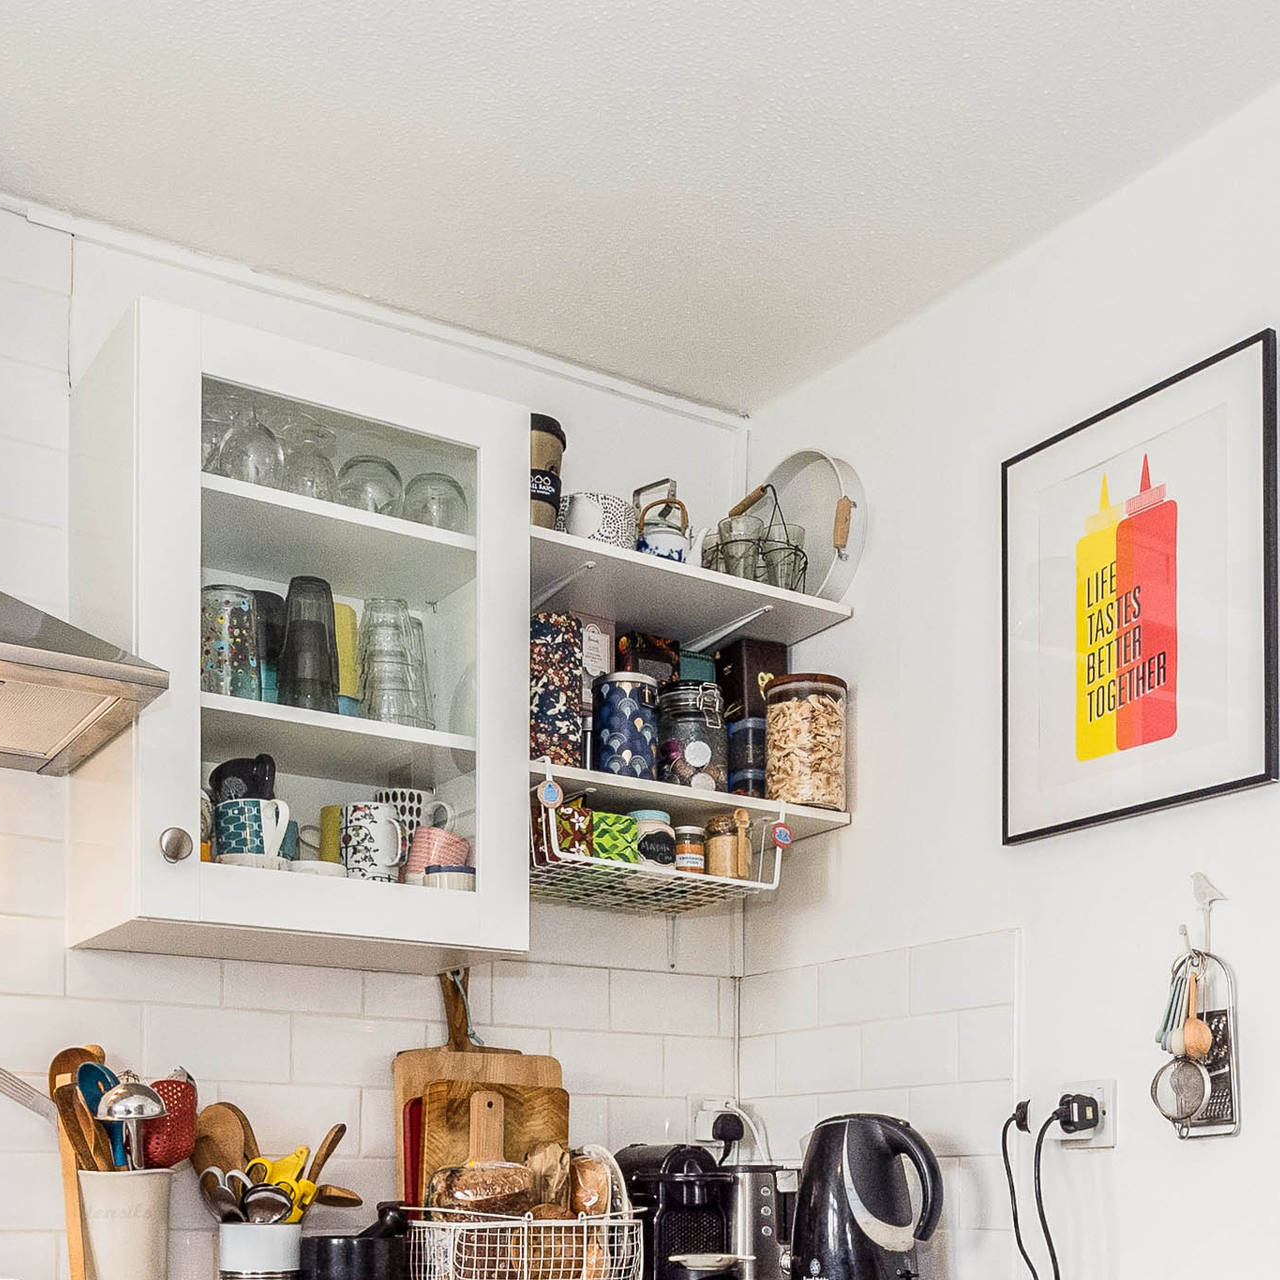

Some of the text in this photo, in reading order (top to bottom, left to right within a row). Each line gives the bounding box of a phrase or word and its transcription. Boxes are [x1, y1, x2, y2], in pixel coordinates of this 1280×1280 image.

[1084, 559, 1119, 610] LIFE
[1086, 584, 1143, 647] TASTES
[1086, 624, 1143, 685] BETTER
[1086, 652, 1168, 724] TOGETHER
